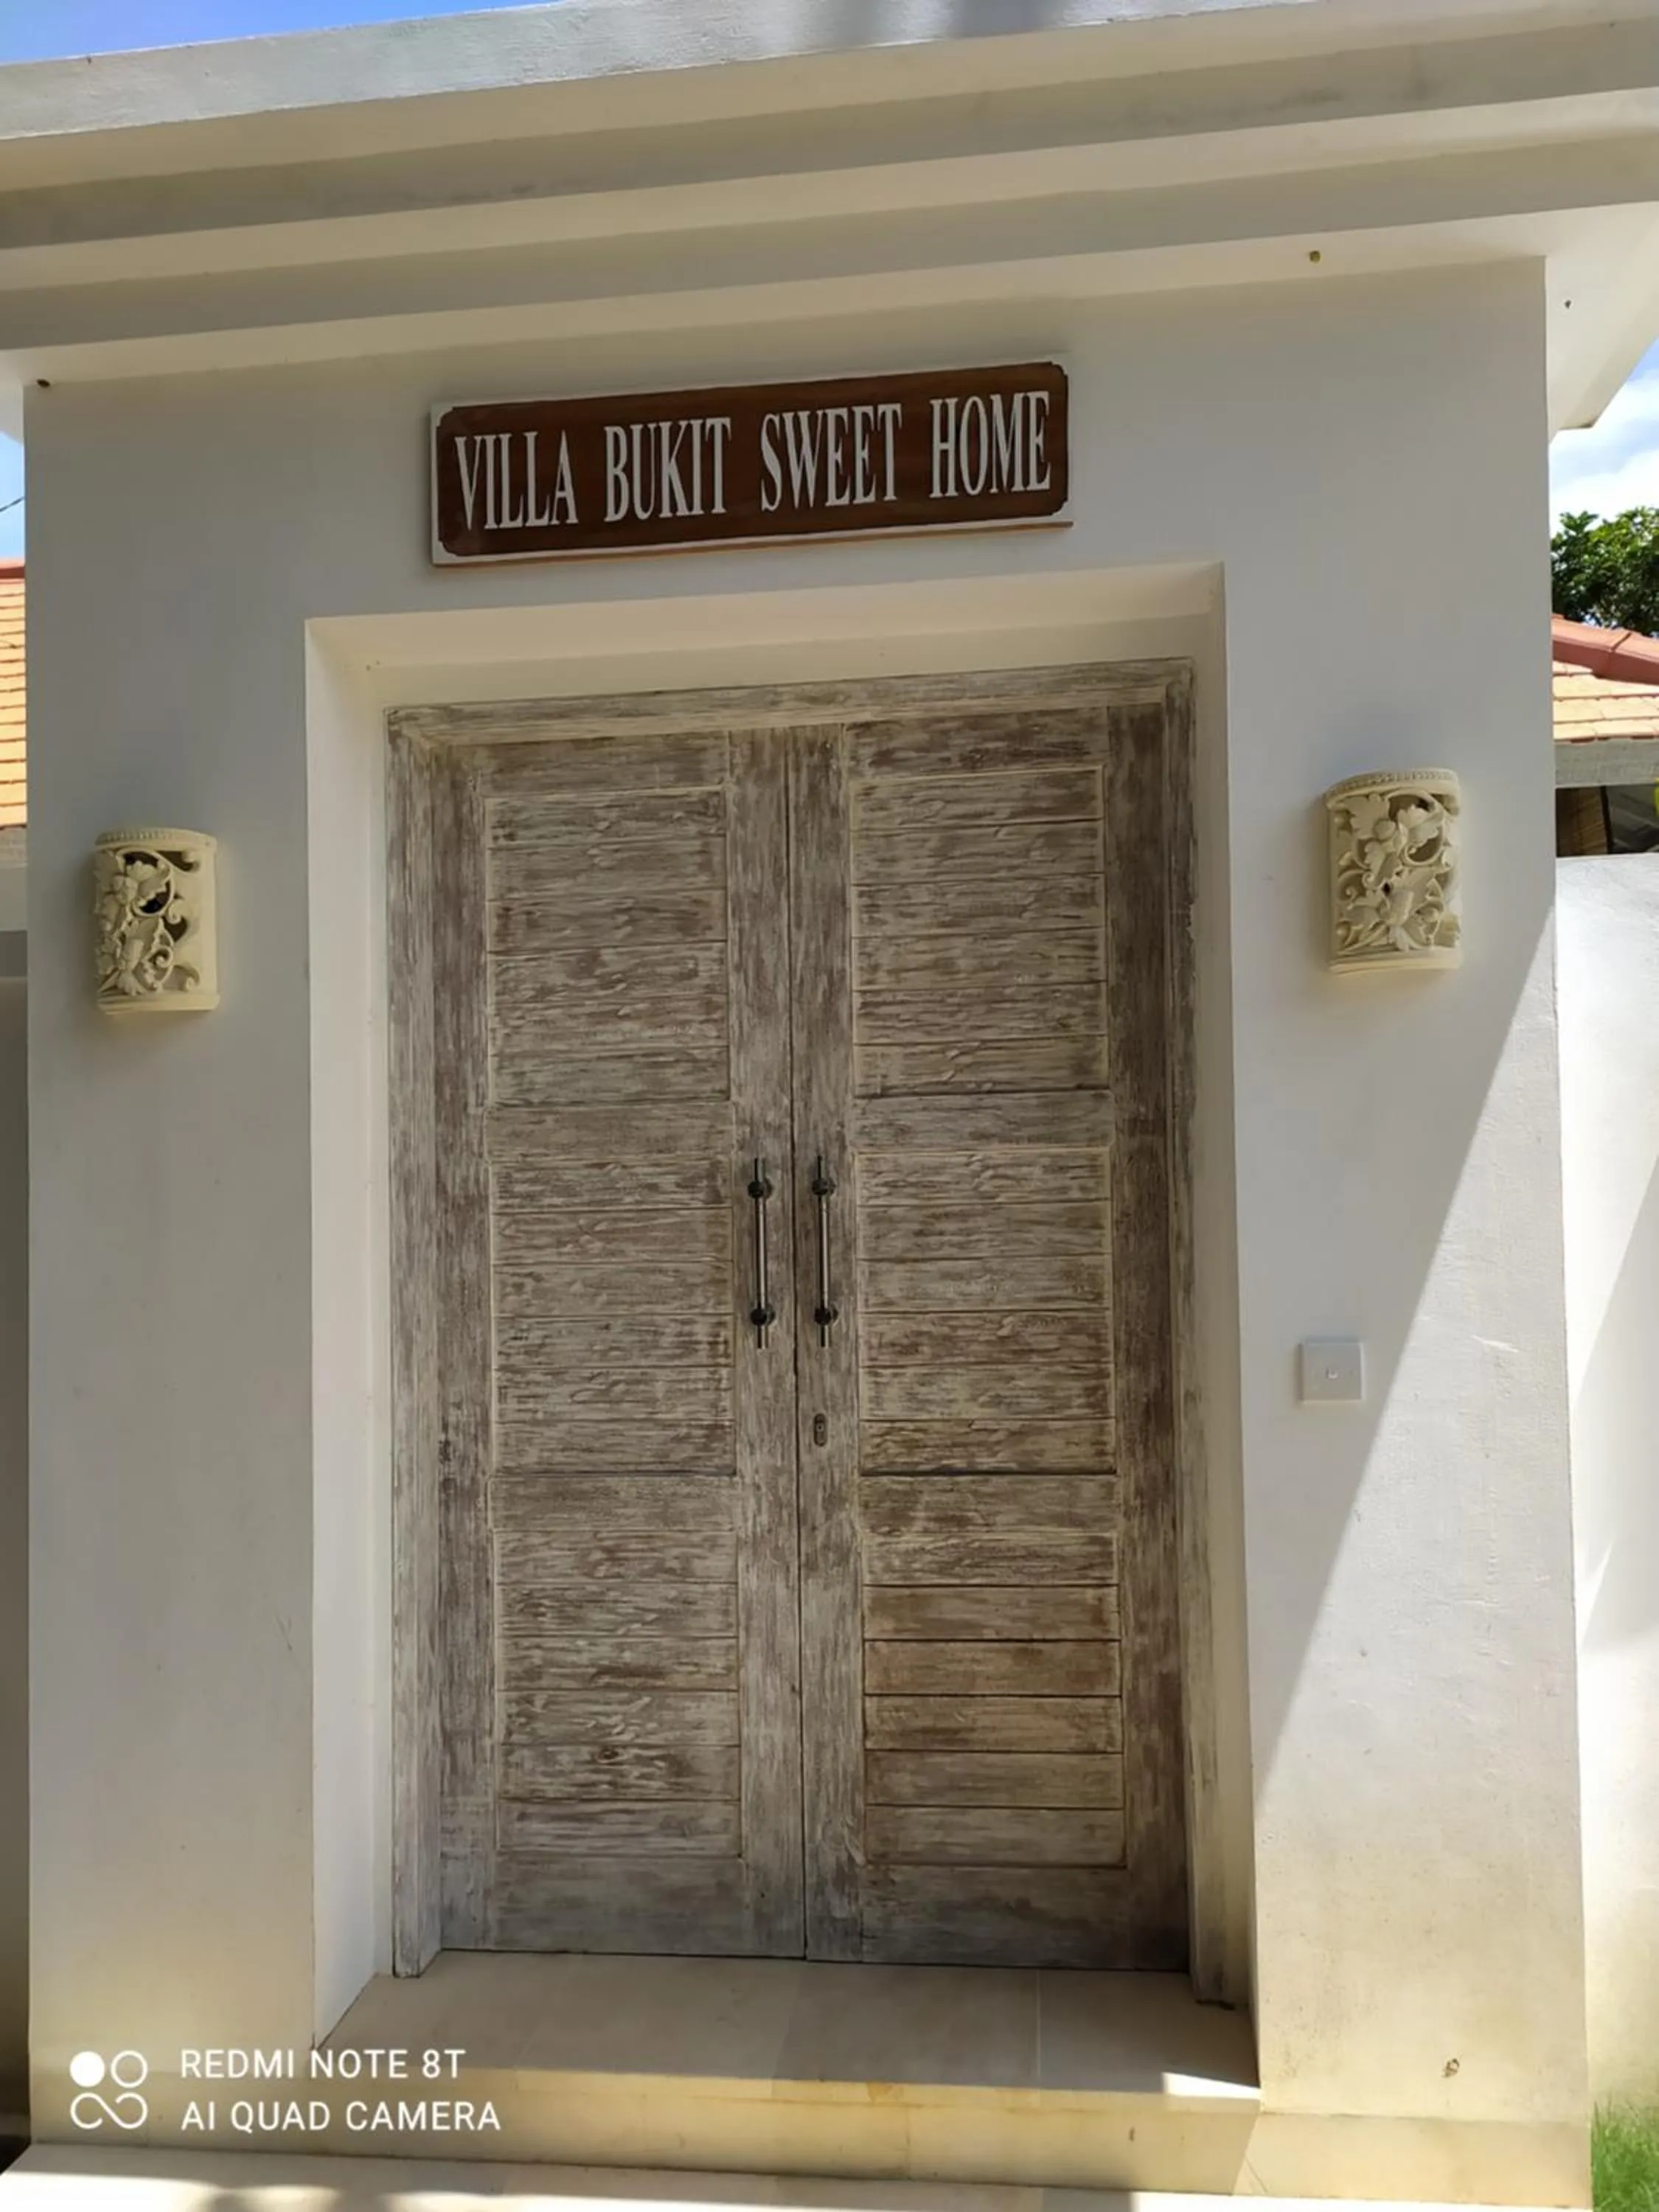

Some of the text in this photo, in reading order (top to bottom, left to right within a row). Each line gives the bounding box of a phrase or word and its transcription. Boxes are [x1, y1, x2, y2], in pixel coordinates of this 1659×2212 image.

[454, 390, 1051, 530] VILLA BUKIT SWEET HOME
